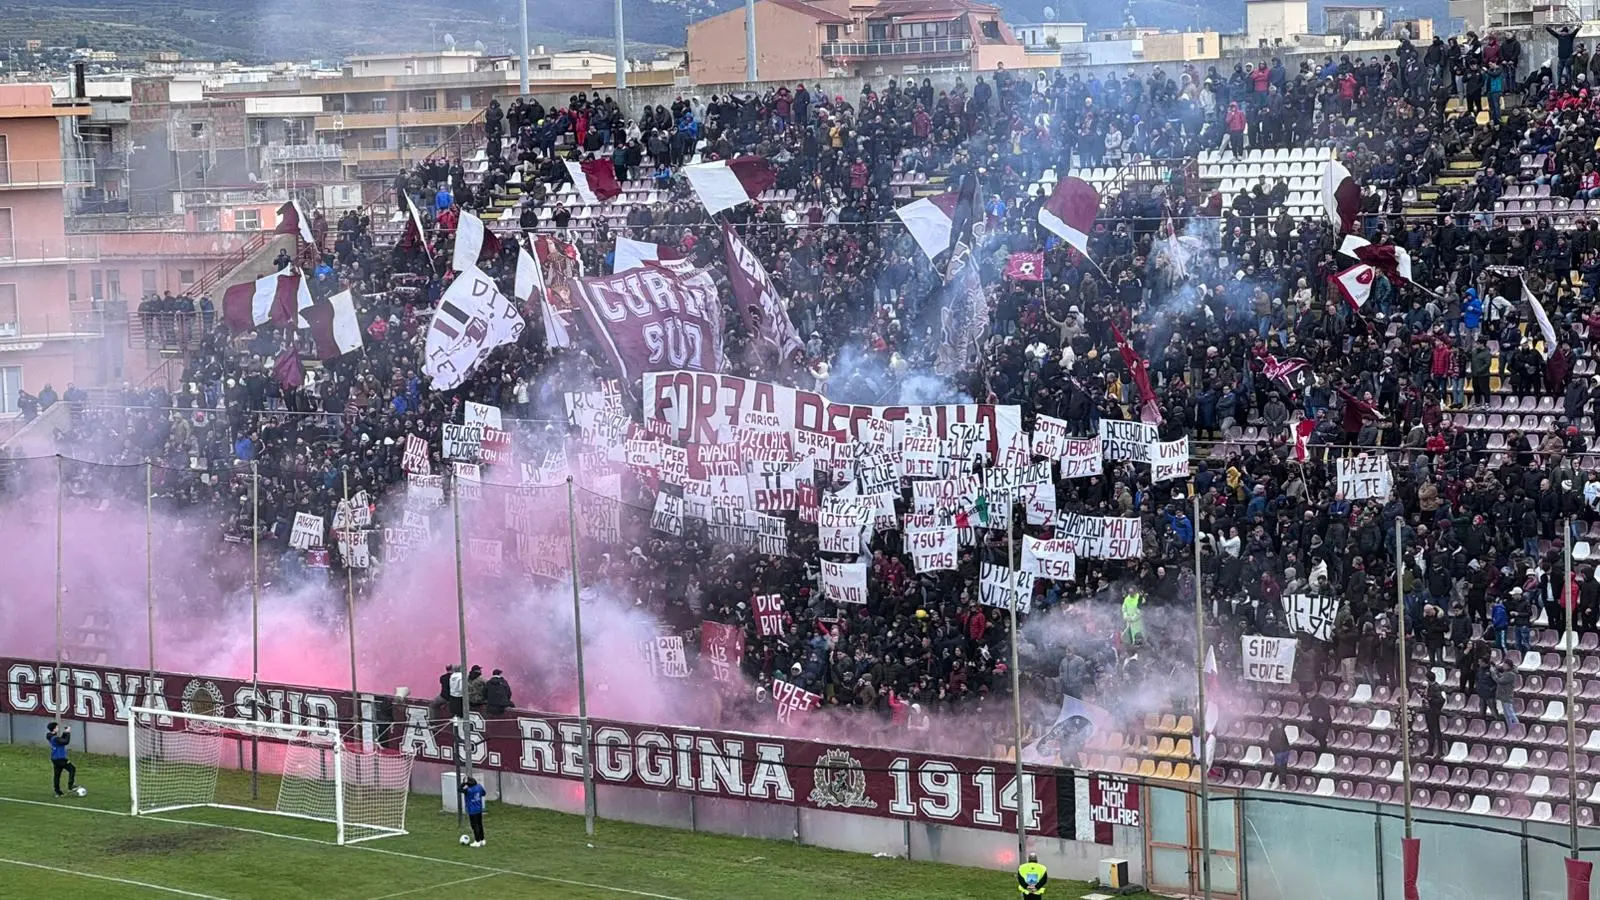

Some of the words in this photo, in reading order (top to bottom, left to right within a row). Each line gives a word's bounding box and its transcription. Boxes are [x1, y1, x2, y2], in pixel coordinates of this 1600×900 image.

[643, 315, 702, 371] SUD
[744, 412, 780, 427] CARICA
[1034, 417, 1067, 437] SOTTO
[444, 425, 470, 442] SOLO
[480, 429, 512, 444] LOTTA
[795, 390, 998, 469] REGNA
[1144, 428, 1158, 443] LA
[628, 441, 657, 454] LOTTA
[740, 430, 788, 449] VECCHIE
[798, 430, 830, 450] BIRRA
[904, 438, 938, 453] PAZZI
[1045, 434, 1056, 445] LA
[450, 441, 479, 458] CUORE
[632, 454, 649, 464] COL
[664, 448, 685, 462] PER
[697, 443, 737, 462] AVANTI
[1102, 439, 1152, 461] PASSIONE
[701, 460, 740, 479] TUTTA
[905, 460, 916, 475] DI
[918, 460, 934, 474] TE
[985, 467, 1012, 488] PER
[1013, 461, 1050, 486] AMORE
[1067, 460, 1081, 476] DI
[1081, 459, 1096, 473] TE
[1342, 456, 1383, 475] PAZZI
[720, 477, 729, 493] 1
[760, 471, 782, 490] TI
[1342, 480, 1357, 498] DI
[1361, 479, 1380, 496] TE
[663, 494, 681, 515] SEI
[713, 495, 745, 509] FISSO
[755, 489, 796, 511] AMO
[802, 487, 814, 503] TI
[651, 509, 684, 538] UNICA
[1103, 518, 1127, 539] MAI
[823, 537, 855, 552] VINCI
[1032, 541, 1040, 551] A
[1036, 558, 1070, 577] TESA
[842, 585, 861, 601] VOI
[773, 679, 816, 711] 0965
[7, 663, 174, 728] CURVA
[232, 686, 339, 745] SUD
[400, 704, 501, 767] A.S.
[517, 716, 795, 802] REGGINA
[888, 757, 1043, 831] 1914
[1102, 791, 1125, 808] NON
[1090, 804, 1140, 827] MOLLARE
